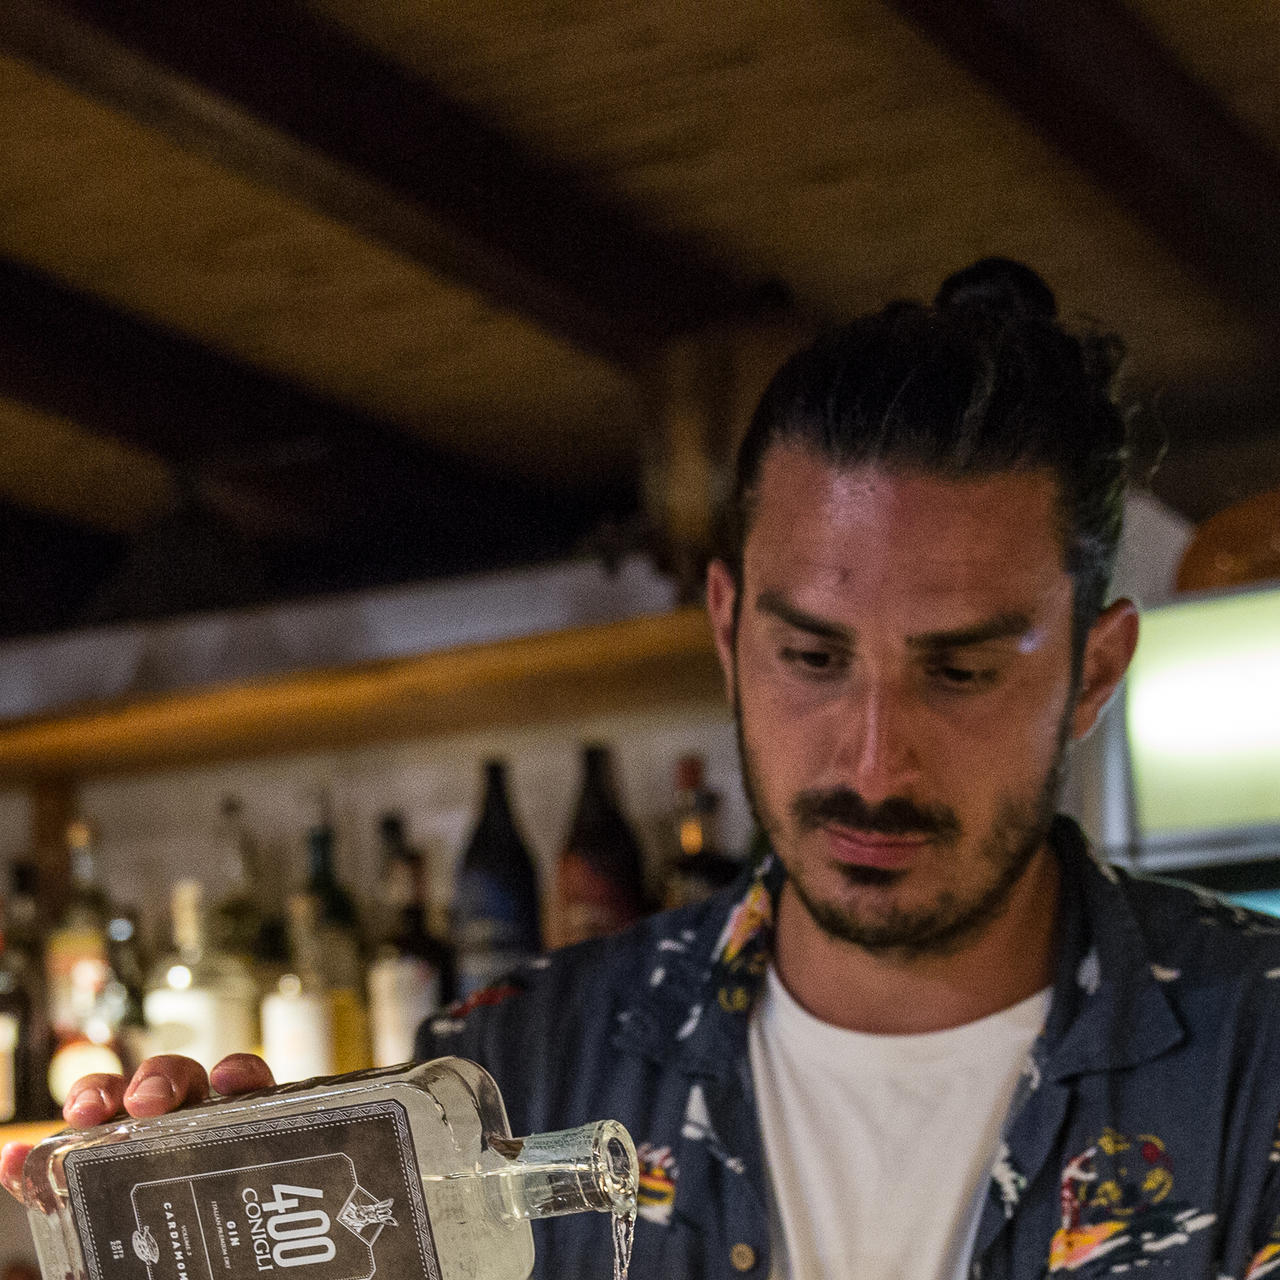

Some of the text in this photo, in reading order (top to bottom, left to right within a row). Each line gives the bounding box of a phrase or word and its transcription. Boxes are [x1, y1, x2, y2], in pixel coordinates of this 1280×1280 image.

[211, 1201, 222, 1226] ITALIAN
[261, 1184, 337, 1268] 400
[216, 1226, 227, 1255] PREMIUM
[226, 1220, 240, 1247] GIN
[242, 1187, 273, 1272] CONIGLI
